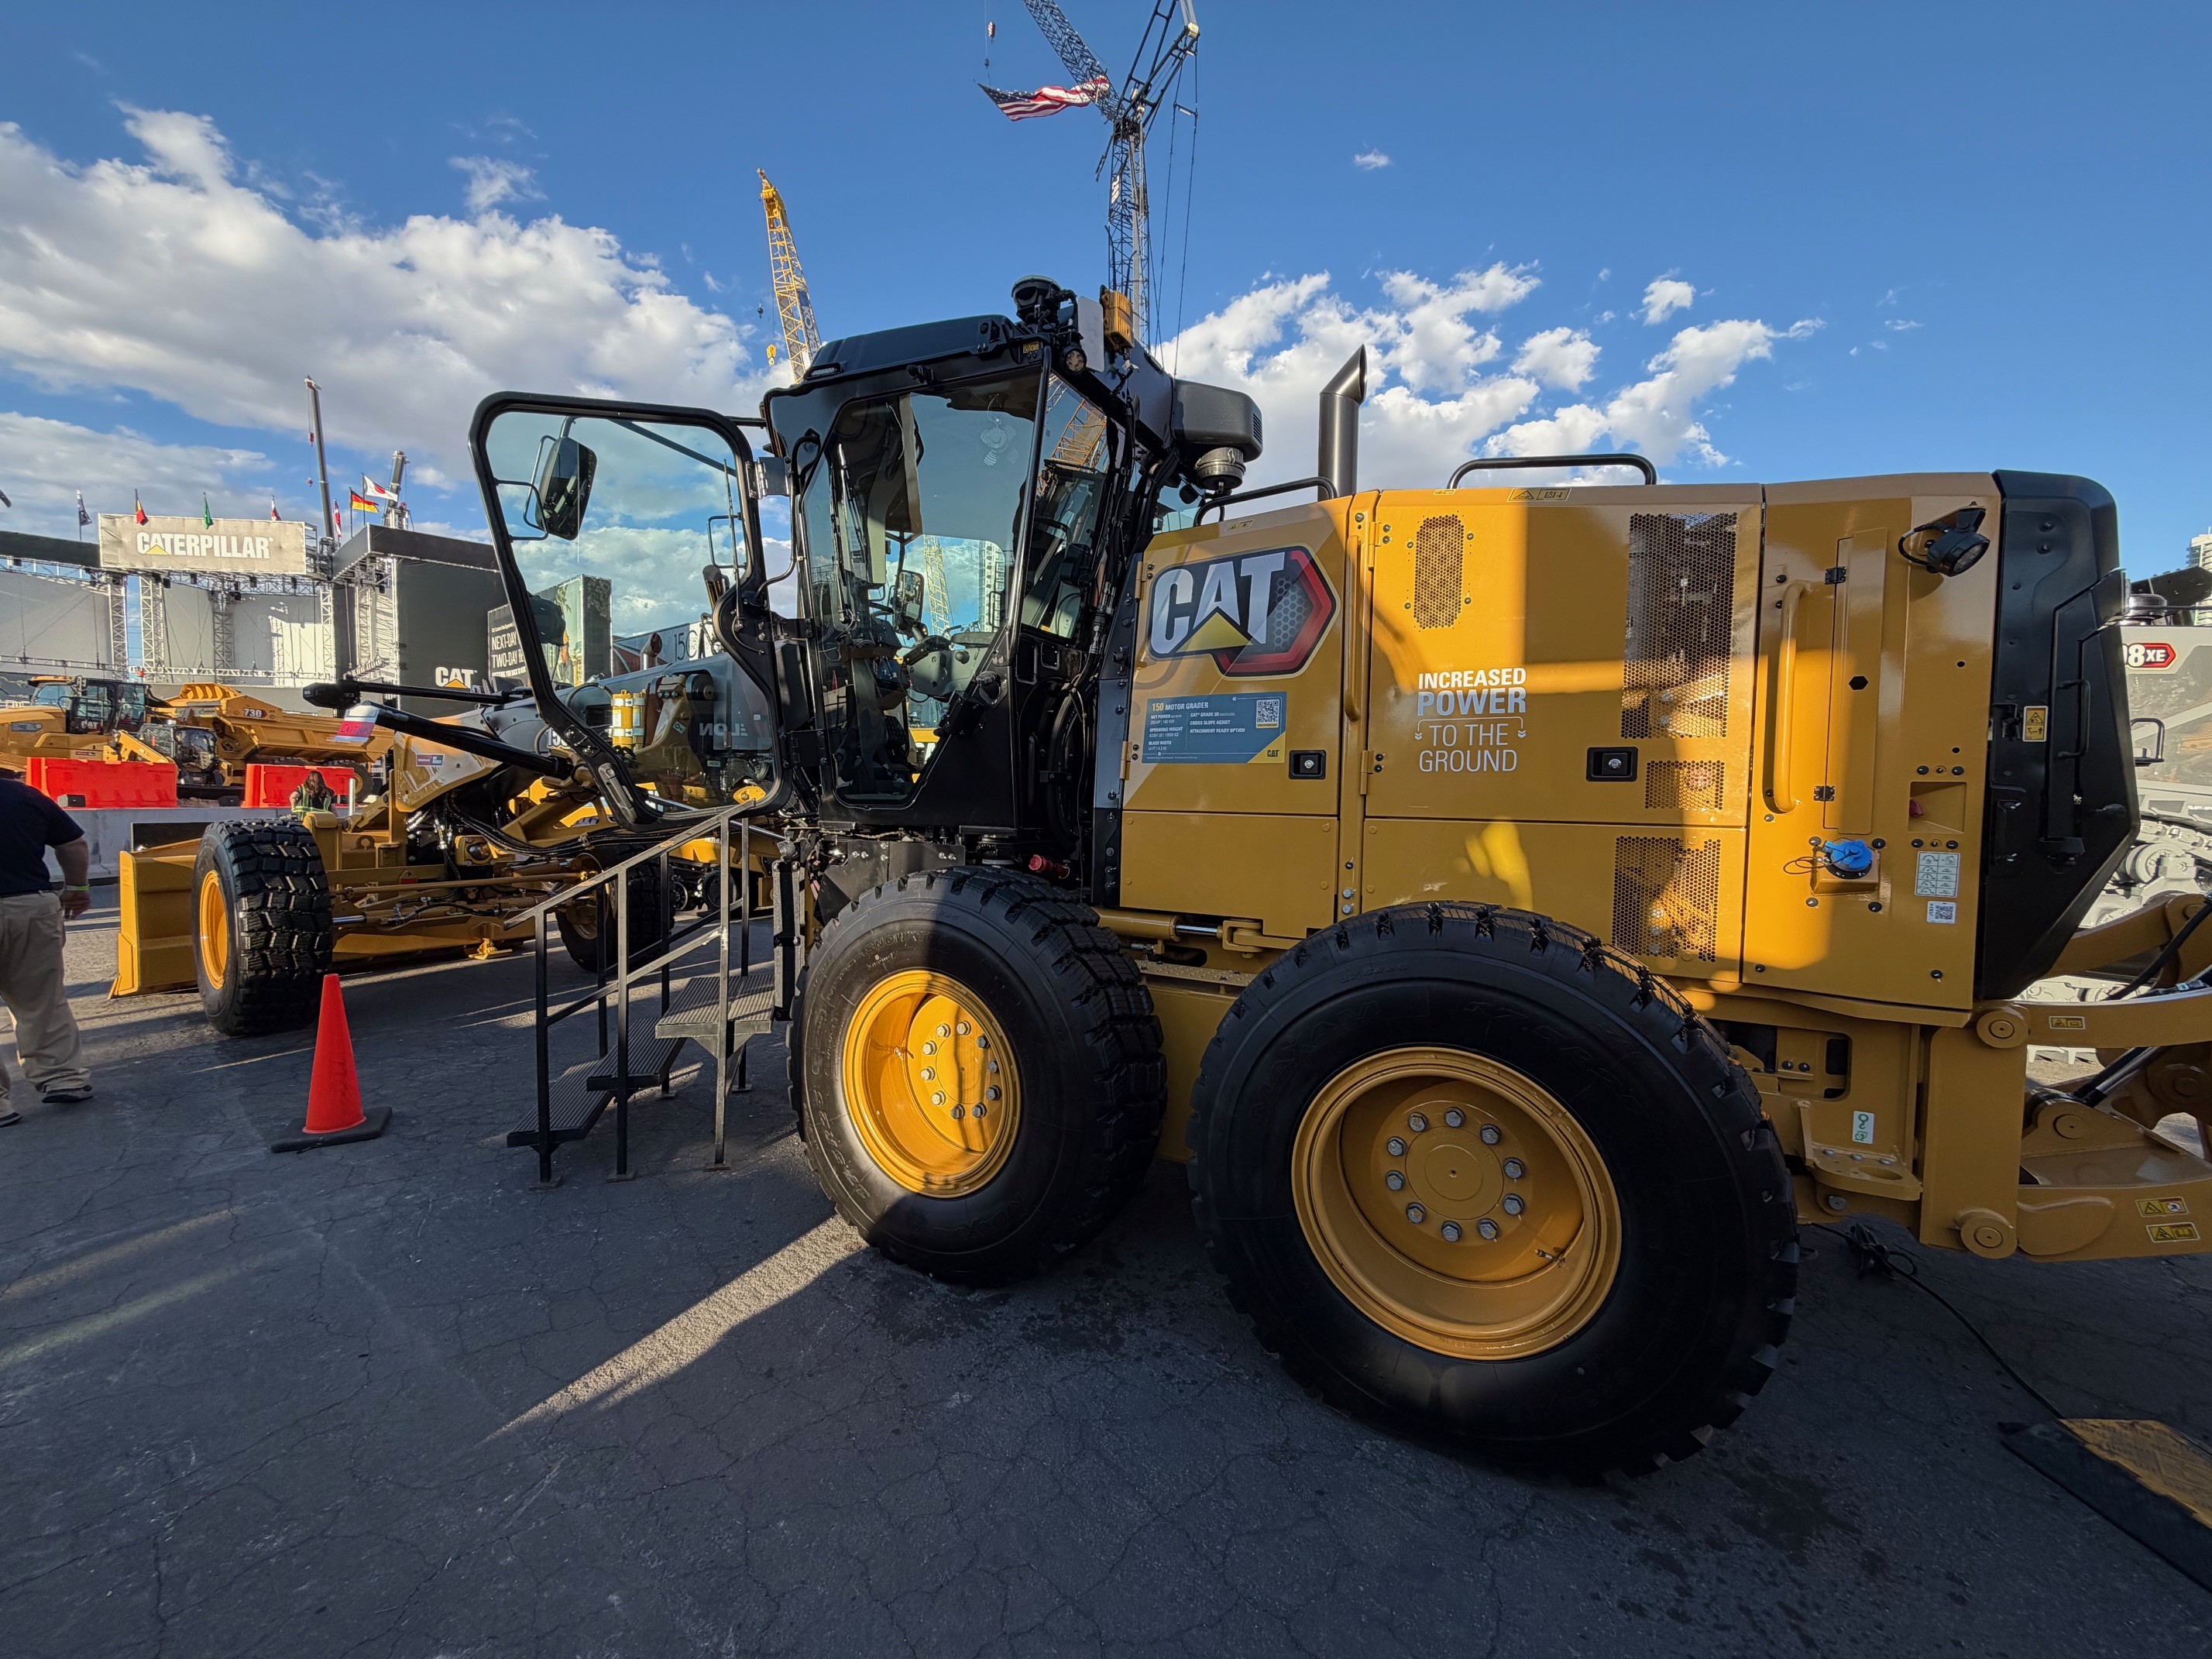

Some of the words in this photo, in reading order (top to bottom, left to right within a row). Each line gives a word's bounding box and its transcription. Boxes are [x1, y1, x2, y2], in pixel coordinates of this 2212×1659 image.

[136, 531, 270, 559] CATERPILLAR
[1150, 551, 1286, 654] CAT
[492, 631, 517, 651] NEXT-DAY
[492, 650, 517, 668] TWO-DAY
[435, 666, 474, 689] CAT
[1418, 668, 1527, 689] INCREASED
[1152, 702, 1164, 711] 150
[1417, 687, 1527, 716] POWER
[243, 708, 263, 718] 730
[1429, 724, 1457, 747] TO
[1465, 723, 1509, 746] THE
[1419, 750, 1517, 772] GROUND
